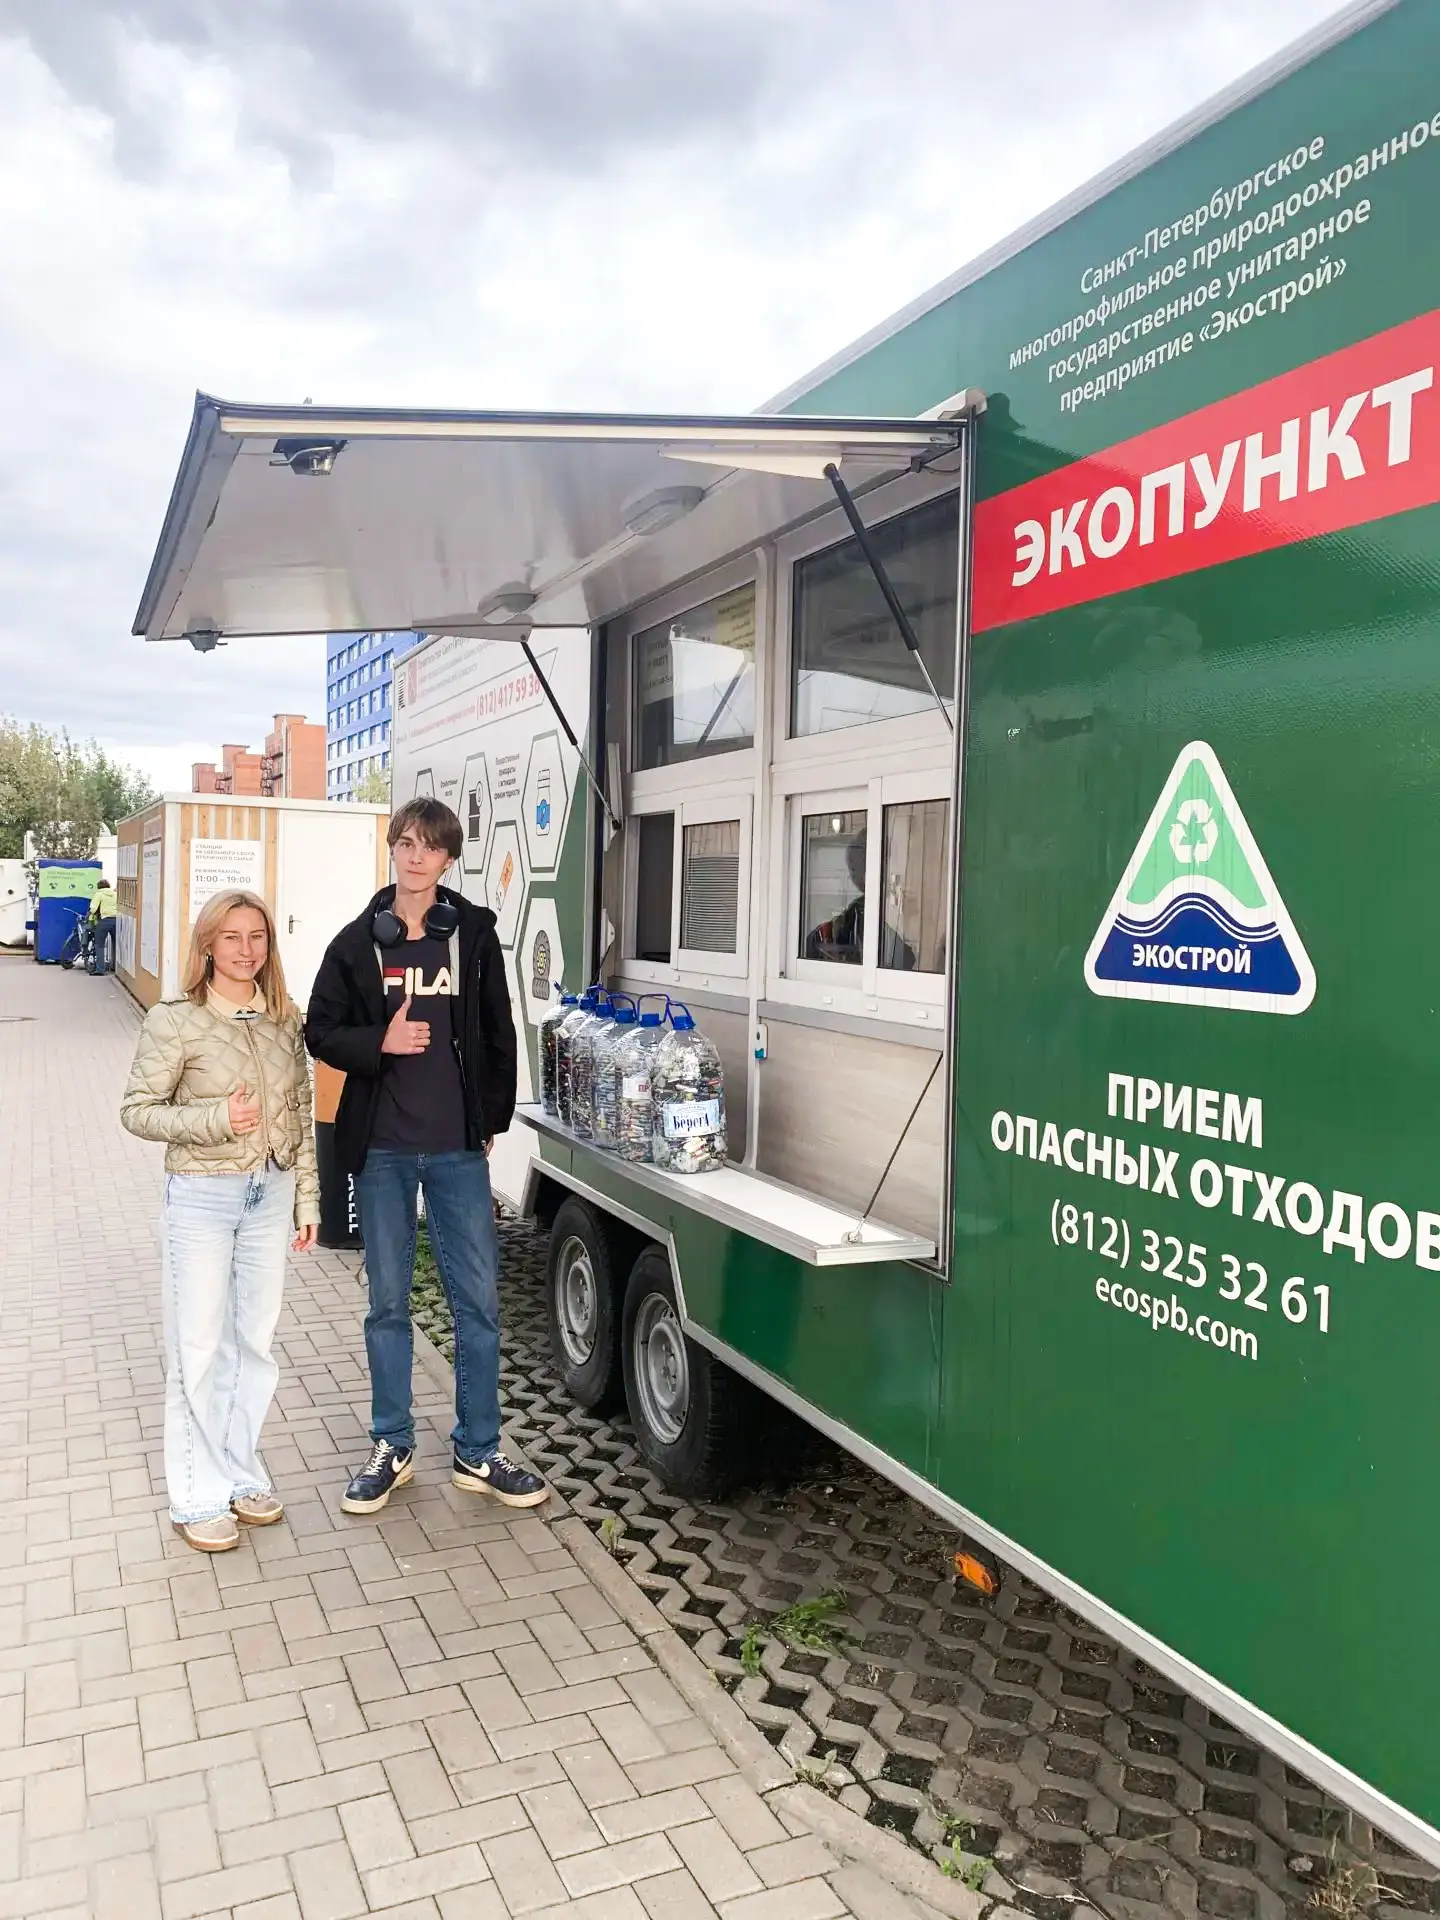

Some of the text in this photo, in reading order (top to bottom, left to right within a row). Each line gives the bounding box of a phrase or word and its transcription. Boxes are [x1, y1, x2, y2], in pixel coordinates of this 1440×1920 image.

[1009, 111, 1440, 370] многопрофильное природоохранное
[1080, 136, 1325, 294] Санкт-Петербургское
[1048, 199, 1371, 383] государственное унитарное
[1060, 255, 1347, 412] предприятие «Экострой»
[1012, 366, 1433, 587] ЭКОПУНКТ
[195, 875, 218, 883] 11:00
[383, 967, 451, 996] FILA
[1132, 943, 1251, 974] ЭКОСТРОЙ
[1107, 1072, 1263, 1148] ПРИЕМ
[991, 1110, 1440, 1272] ОПАСНЫХ ОТХОДОВ
[1051, 1199, 1330, 1334] (812) 325 32 61
[1095, 1277, 1258, 1361] ecospb.com
